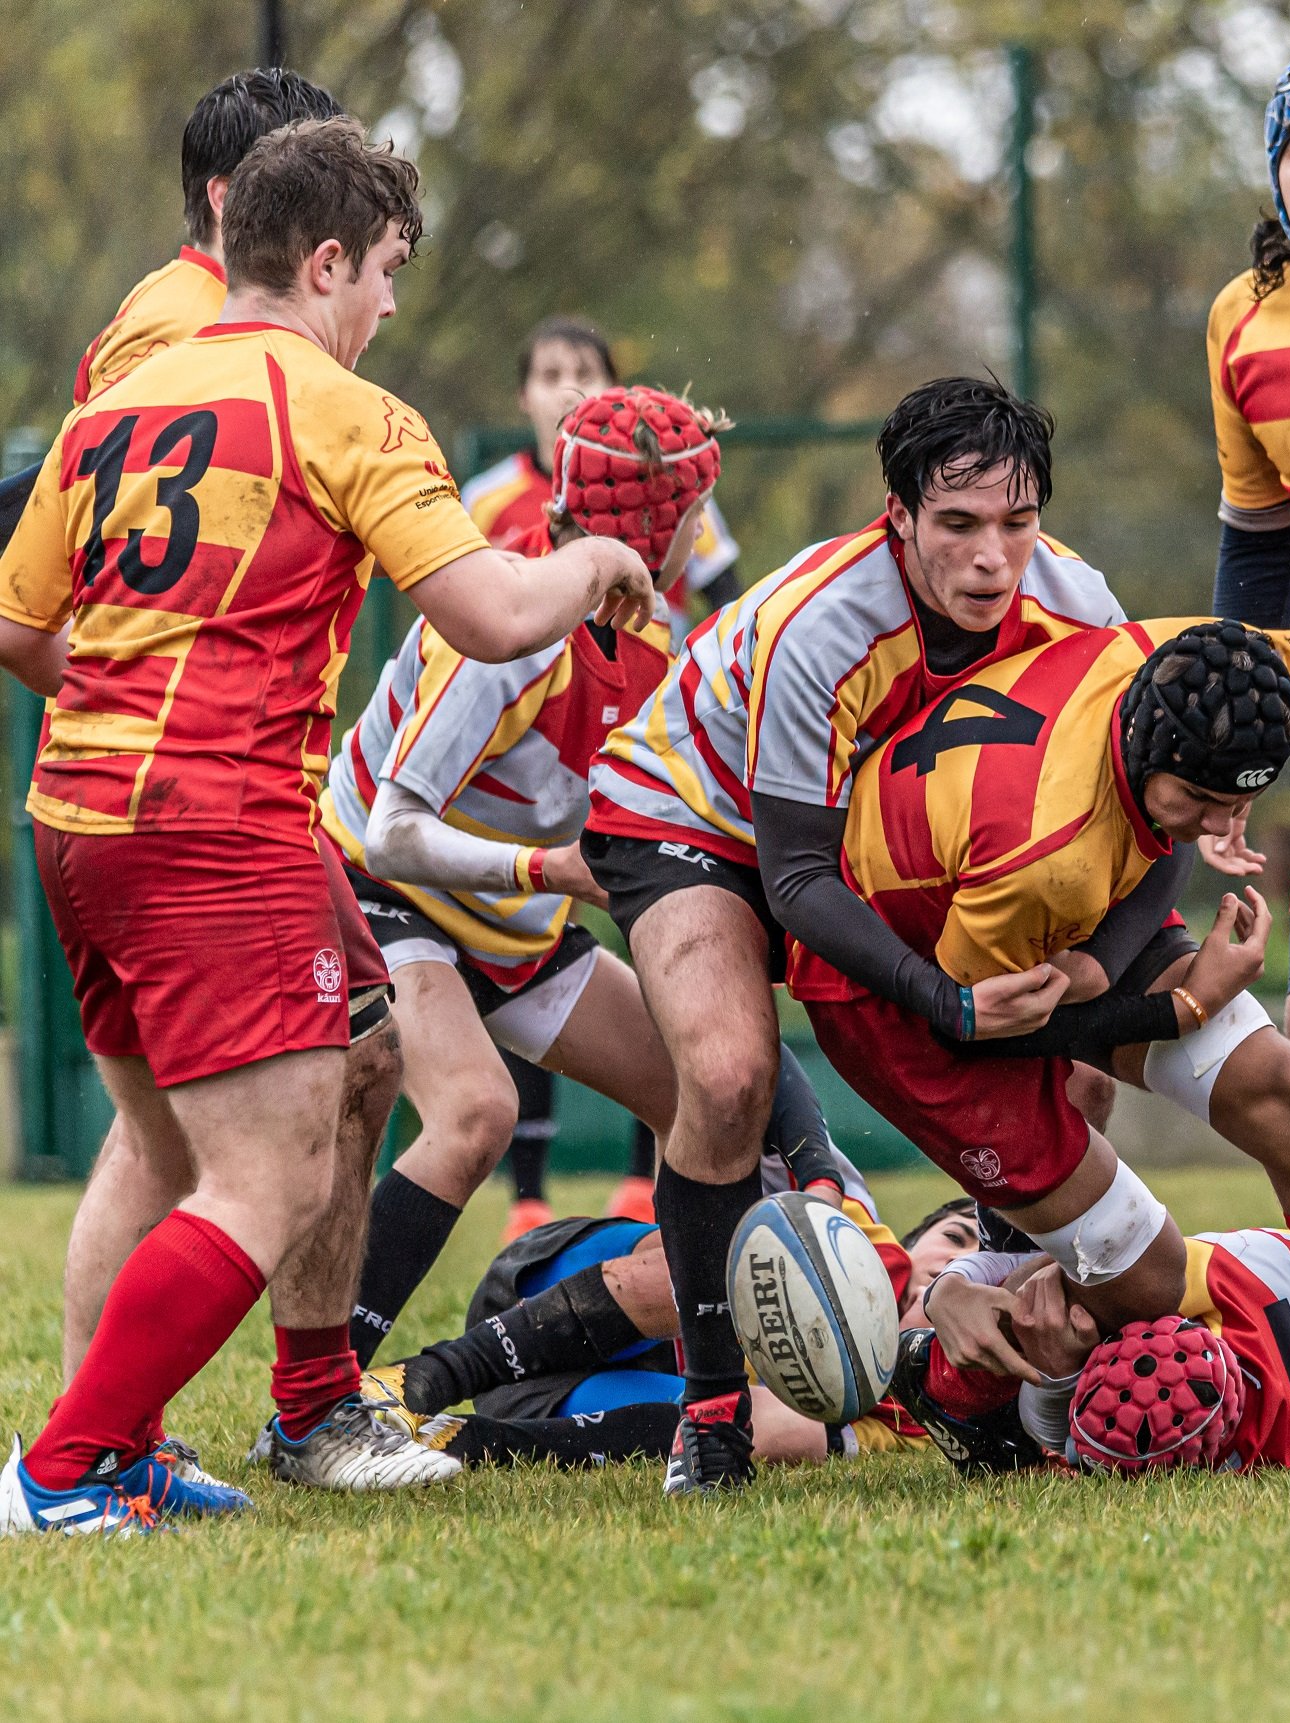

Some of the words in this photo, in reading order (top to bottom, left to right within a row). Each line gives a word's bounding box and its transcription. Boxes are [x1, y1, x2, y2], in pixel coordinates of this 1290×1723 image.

[77, 410, 218, 595] 13
[891, 684, 1047, 779] 4
[658, 841, 718, 872] BLK
[749, 1253, 827, 1414] GILBERT
